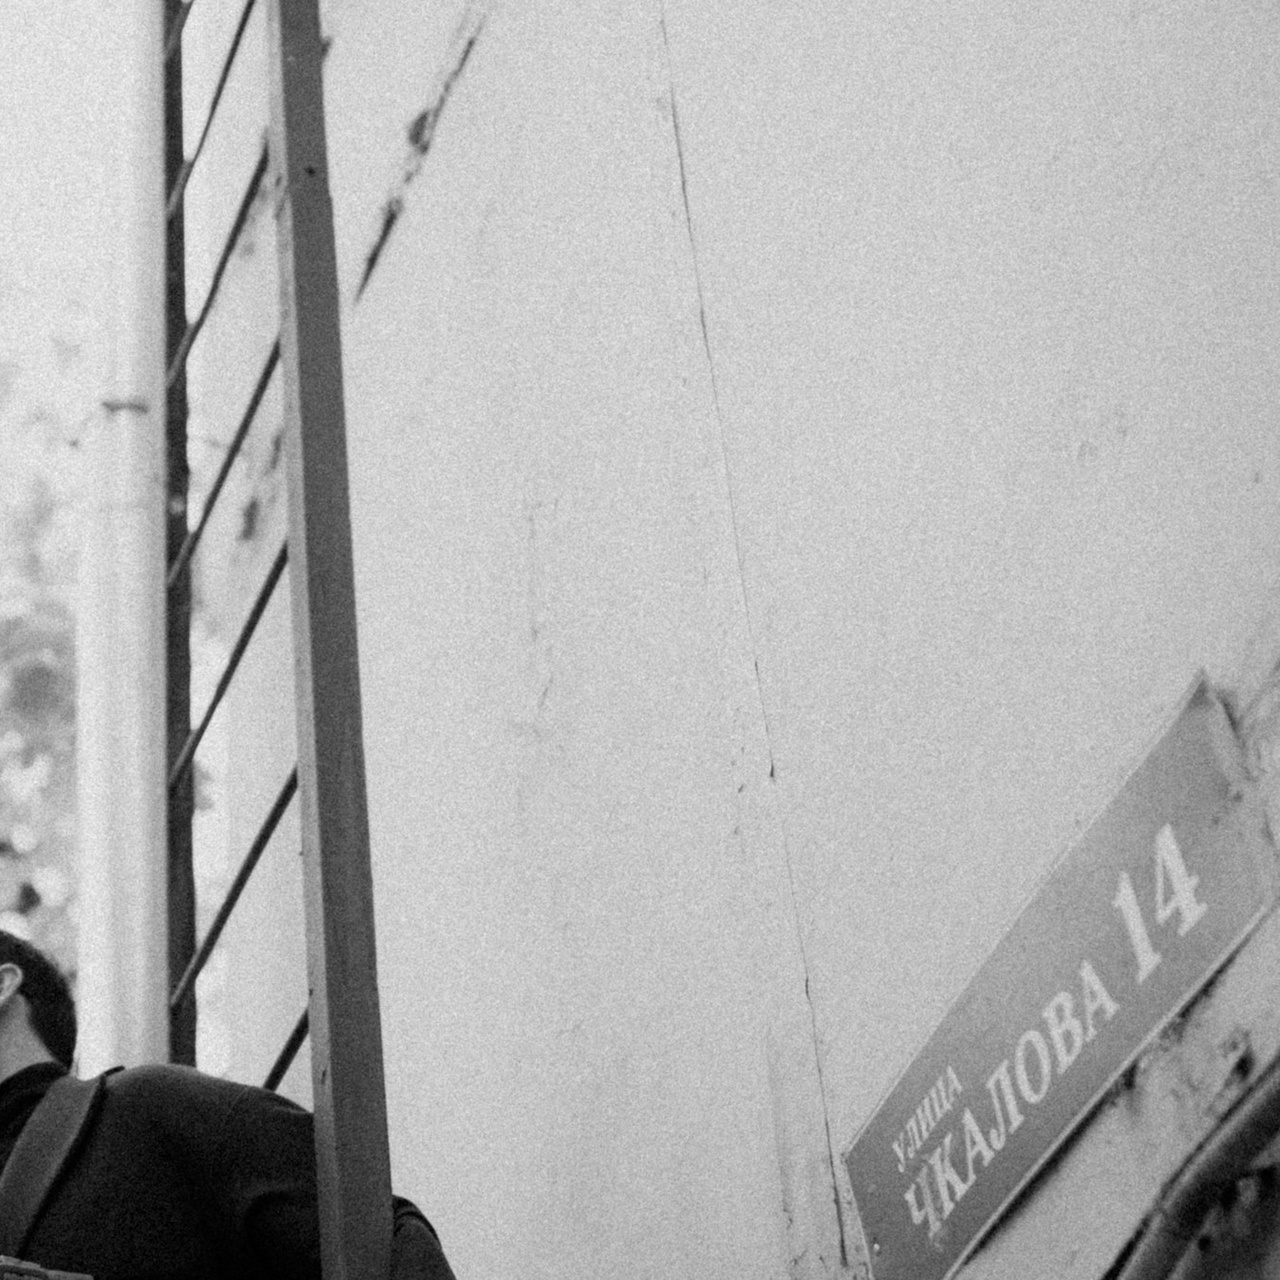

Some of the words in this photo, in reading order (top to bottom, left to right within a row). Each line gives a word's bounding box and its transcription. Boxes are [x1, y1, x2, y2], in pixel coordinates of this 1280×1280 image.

[892, 1066, 964, 1173] УЛИЦА
[903, 959, 1120, 1238] ЧКАЛОВА
[1111, 822, 1207, 984] 14
